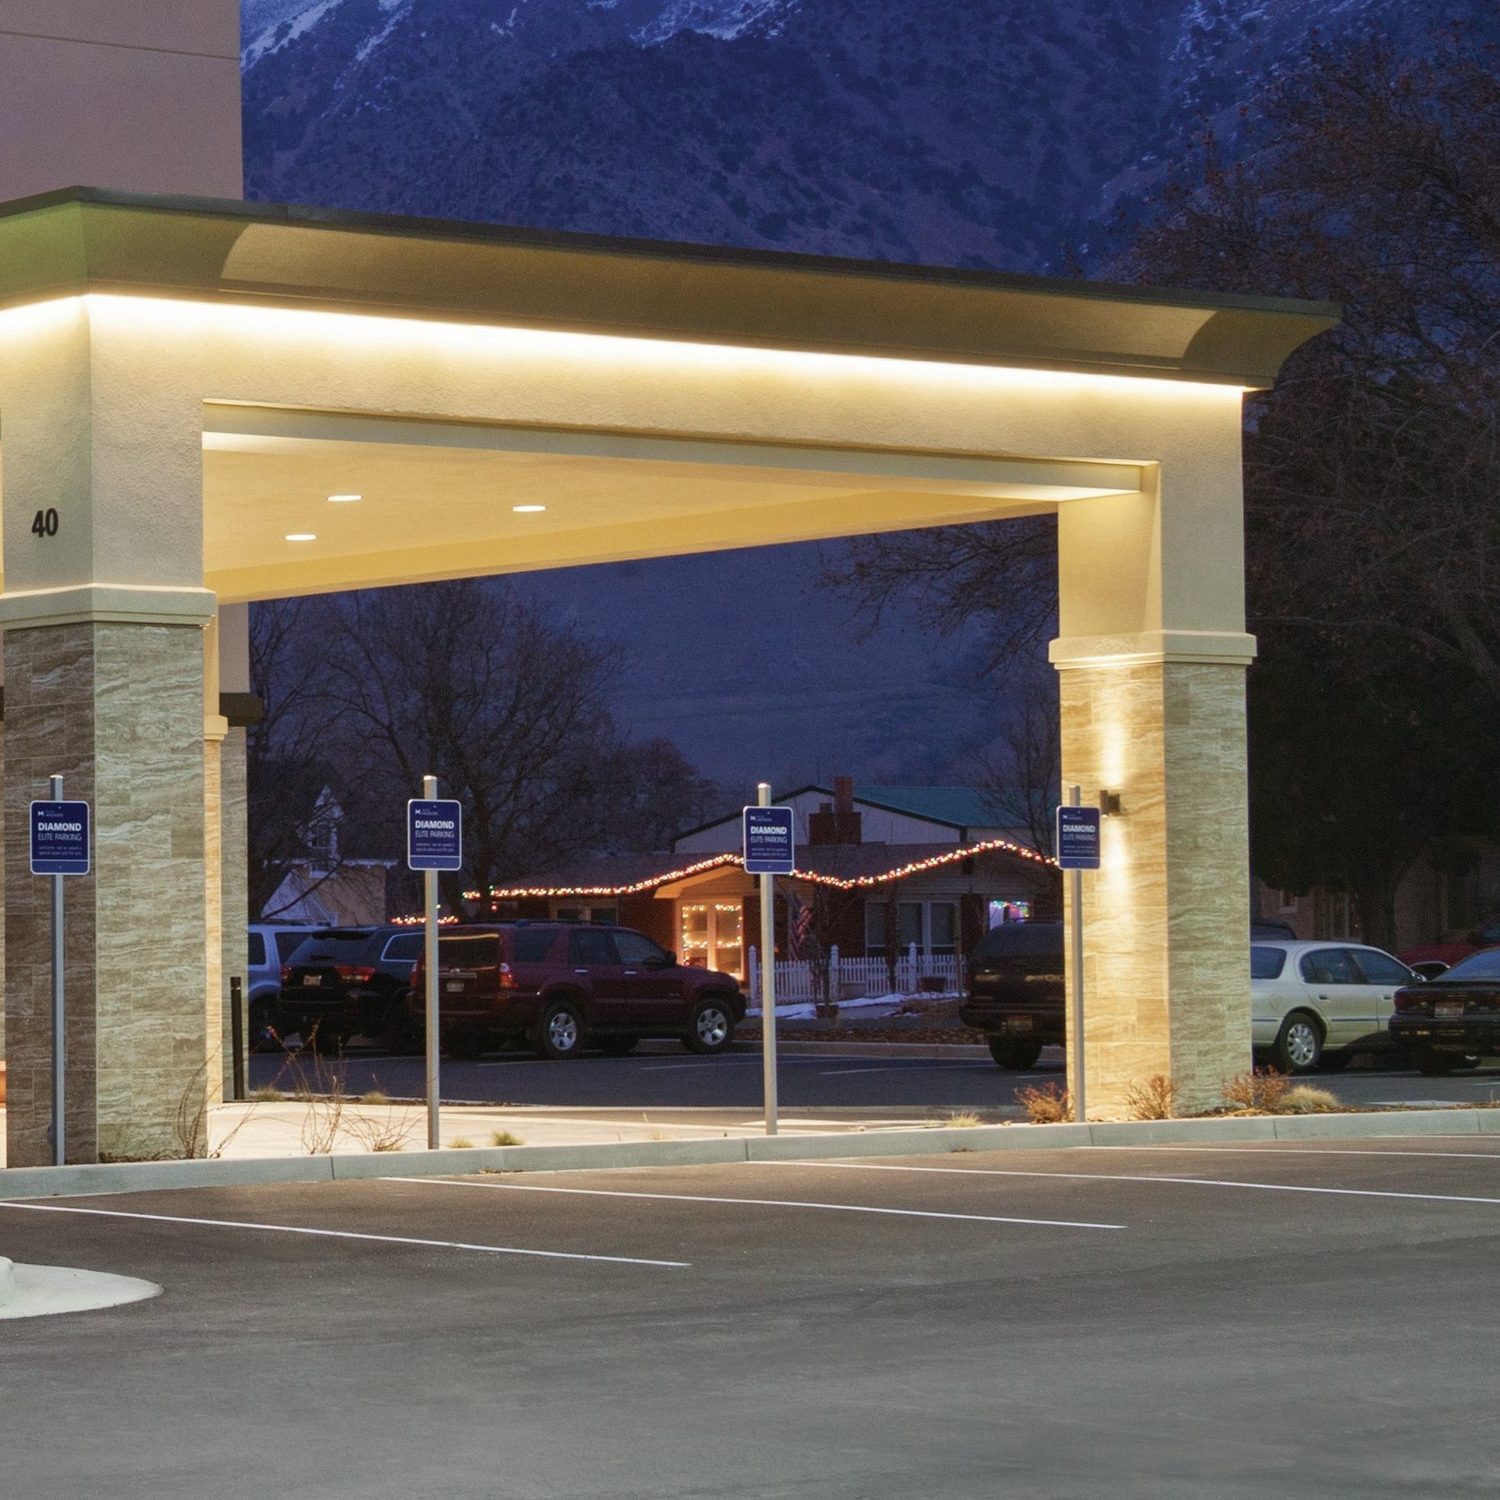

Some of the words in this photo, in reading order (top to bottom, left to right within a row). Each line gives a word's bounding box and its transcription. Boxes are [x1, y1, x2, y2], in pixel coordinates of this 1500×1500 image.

[31, 507, 59, 538] 40
[37, 822, 82, 831] DIAMOND
[415, 820, 455, 829] DIAMOND
[1062, 824, 1096, 832] DIAMOND
[750, 826, 787, 835] DIAMOND
[38, 832, 53, 841] ELITE
[55, 833, 82, 841] PARKING
